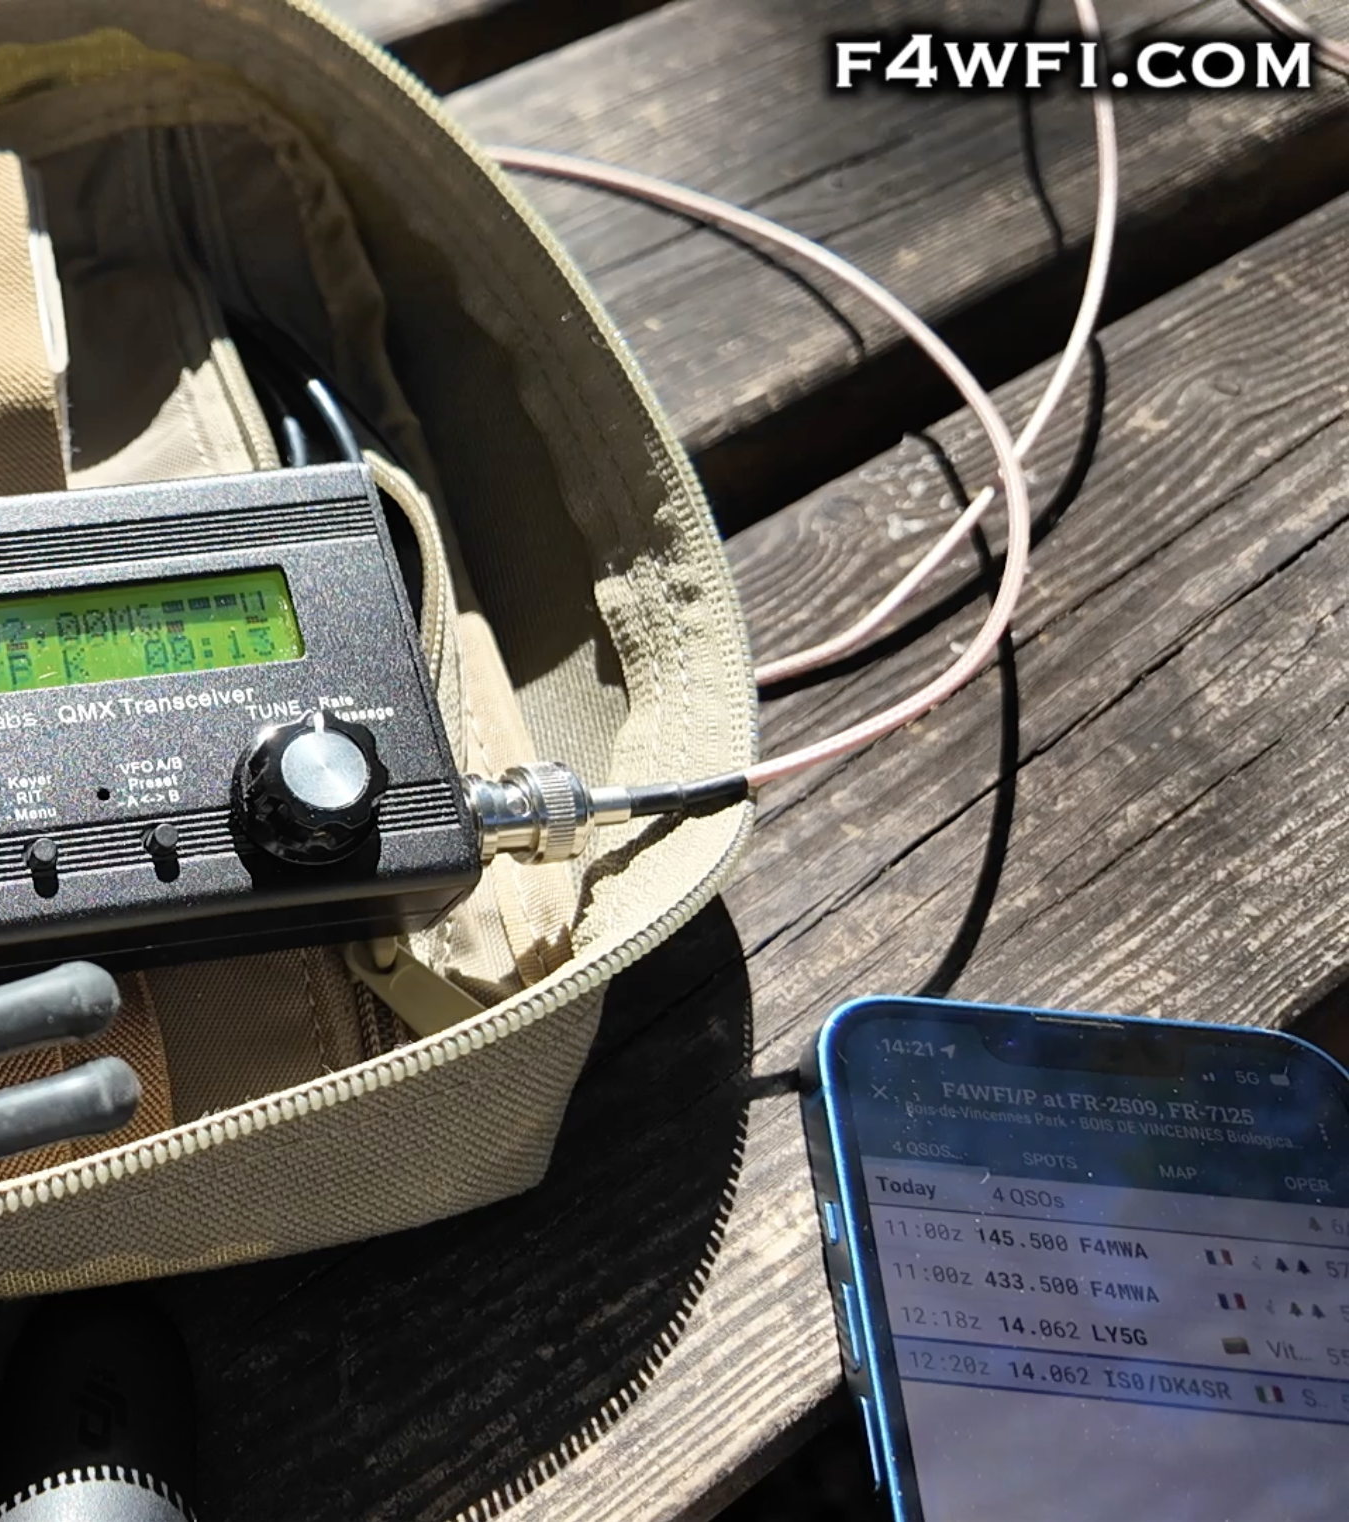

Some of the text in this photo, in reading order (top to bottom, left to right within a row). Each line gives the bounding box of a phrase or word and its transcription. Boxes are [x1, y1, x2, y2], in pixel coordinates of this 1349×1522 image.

[62, 647, 89, 679] K
[144, 626, 276, 668] 00:13
[58, 700, 116, 725] QMX
[118, 687, 255, 717] Transceiver
[245, 699, 302, 720] TUNE
[318, 695, 354, 710] Rate
[335, 706, 394, 722] essage
[118, 756, 183, 775] VFO A/B
[7, 774, 52, 790] Keyer
[128, 774, 178, 791] Preset
[16, 789, 43, 805] RIT
[14, 806, 57, 822] Menu
[881, 1038, 935, 1057] 14:21
[1235, 1069, 1260, 1085] 5G
[942, 1081, 1255, 1125] F4WFI/P at FR-2509, FR-7125
[1034, 1112, 1067, 1128] Park
[1079, 1115, 1114, 1132] BOIS
[1117, 1119, 1137, 1134] DE
[1139, 1121, 1224, 1142] VINCENNES
[1023, 1151, 1078, 1169] SPOTS
[1158, 1164, 1197, 1180] MAP
[876, 1175, 1065, 1209] Today 4 QSOs
[885, 1219, 964, 1243] 11:00z
[976, 1228, 1068, 1252] 145.500
[1079, 1236, 1149, 1260] F4MWA
[892, 1262, 973, 1286] 11:00z
[984, 1270, 1079, 1296] 433.500
[1089, 1280, 1161, 1303] F4MWA
[901, 1306, 982, 1331] 12:18z
[998, 1315, 1082, 1340] 14.062
[1091, 1324, 1149, 1346] LY5G
[909, 1351, 991, 1376] 12:20z
[1008, 1361, 1092, 1386] 14.062
